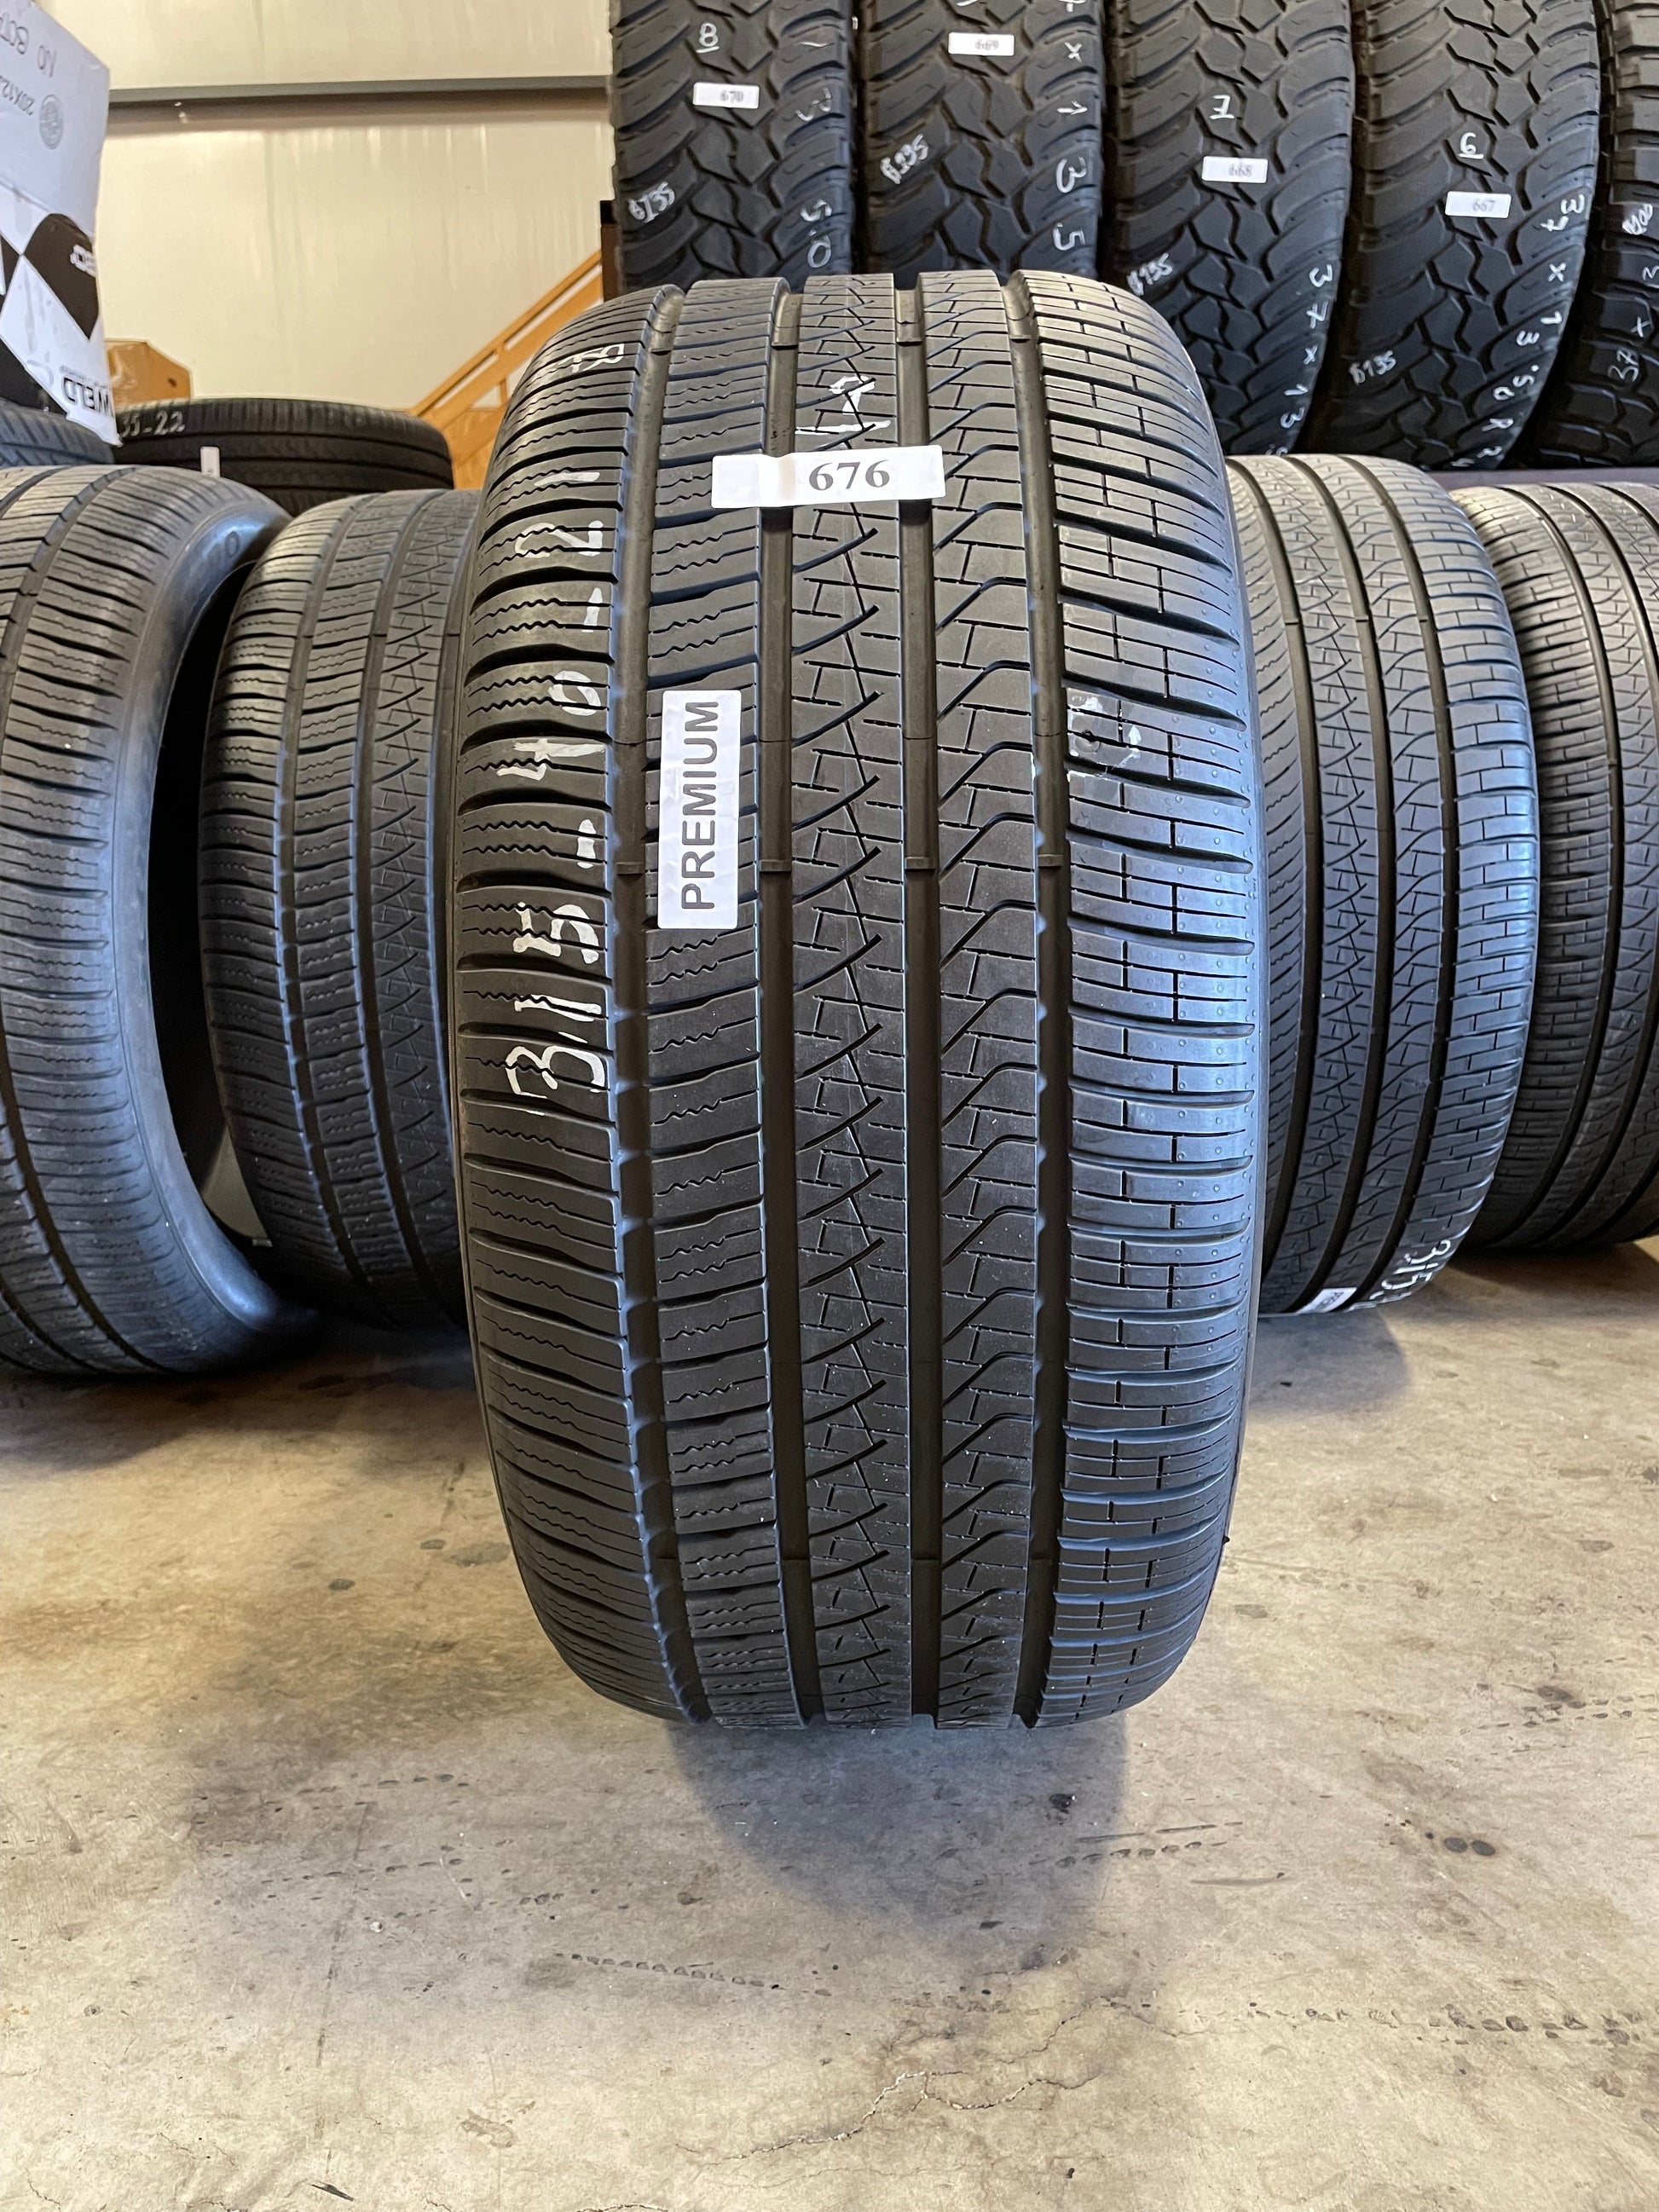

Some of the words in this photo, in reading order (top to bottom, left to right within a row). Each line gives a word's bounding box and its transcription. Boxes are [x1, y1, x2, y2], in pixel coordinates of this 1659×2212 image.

[720, 89, 745, 103] 670
[1460, 132, 1477, 154] 6
[1471, 197, 1496, 212] 667
[809, 459, 890, 491] 676
[680, 701, 719, 910] PREMIUM
